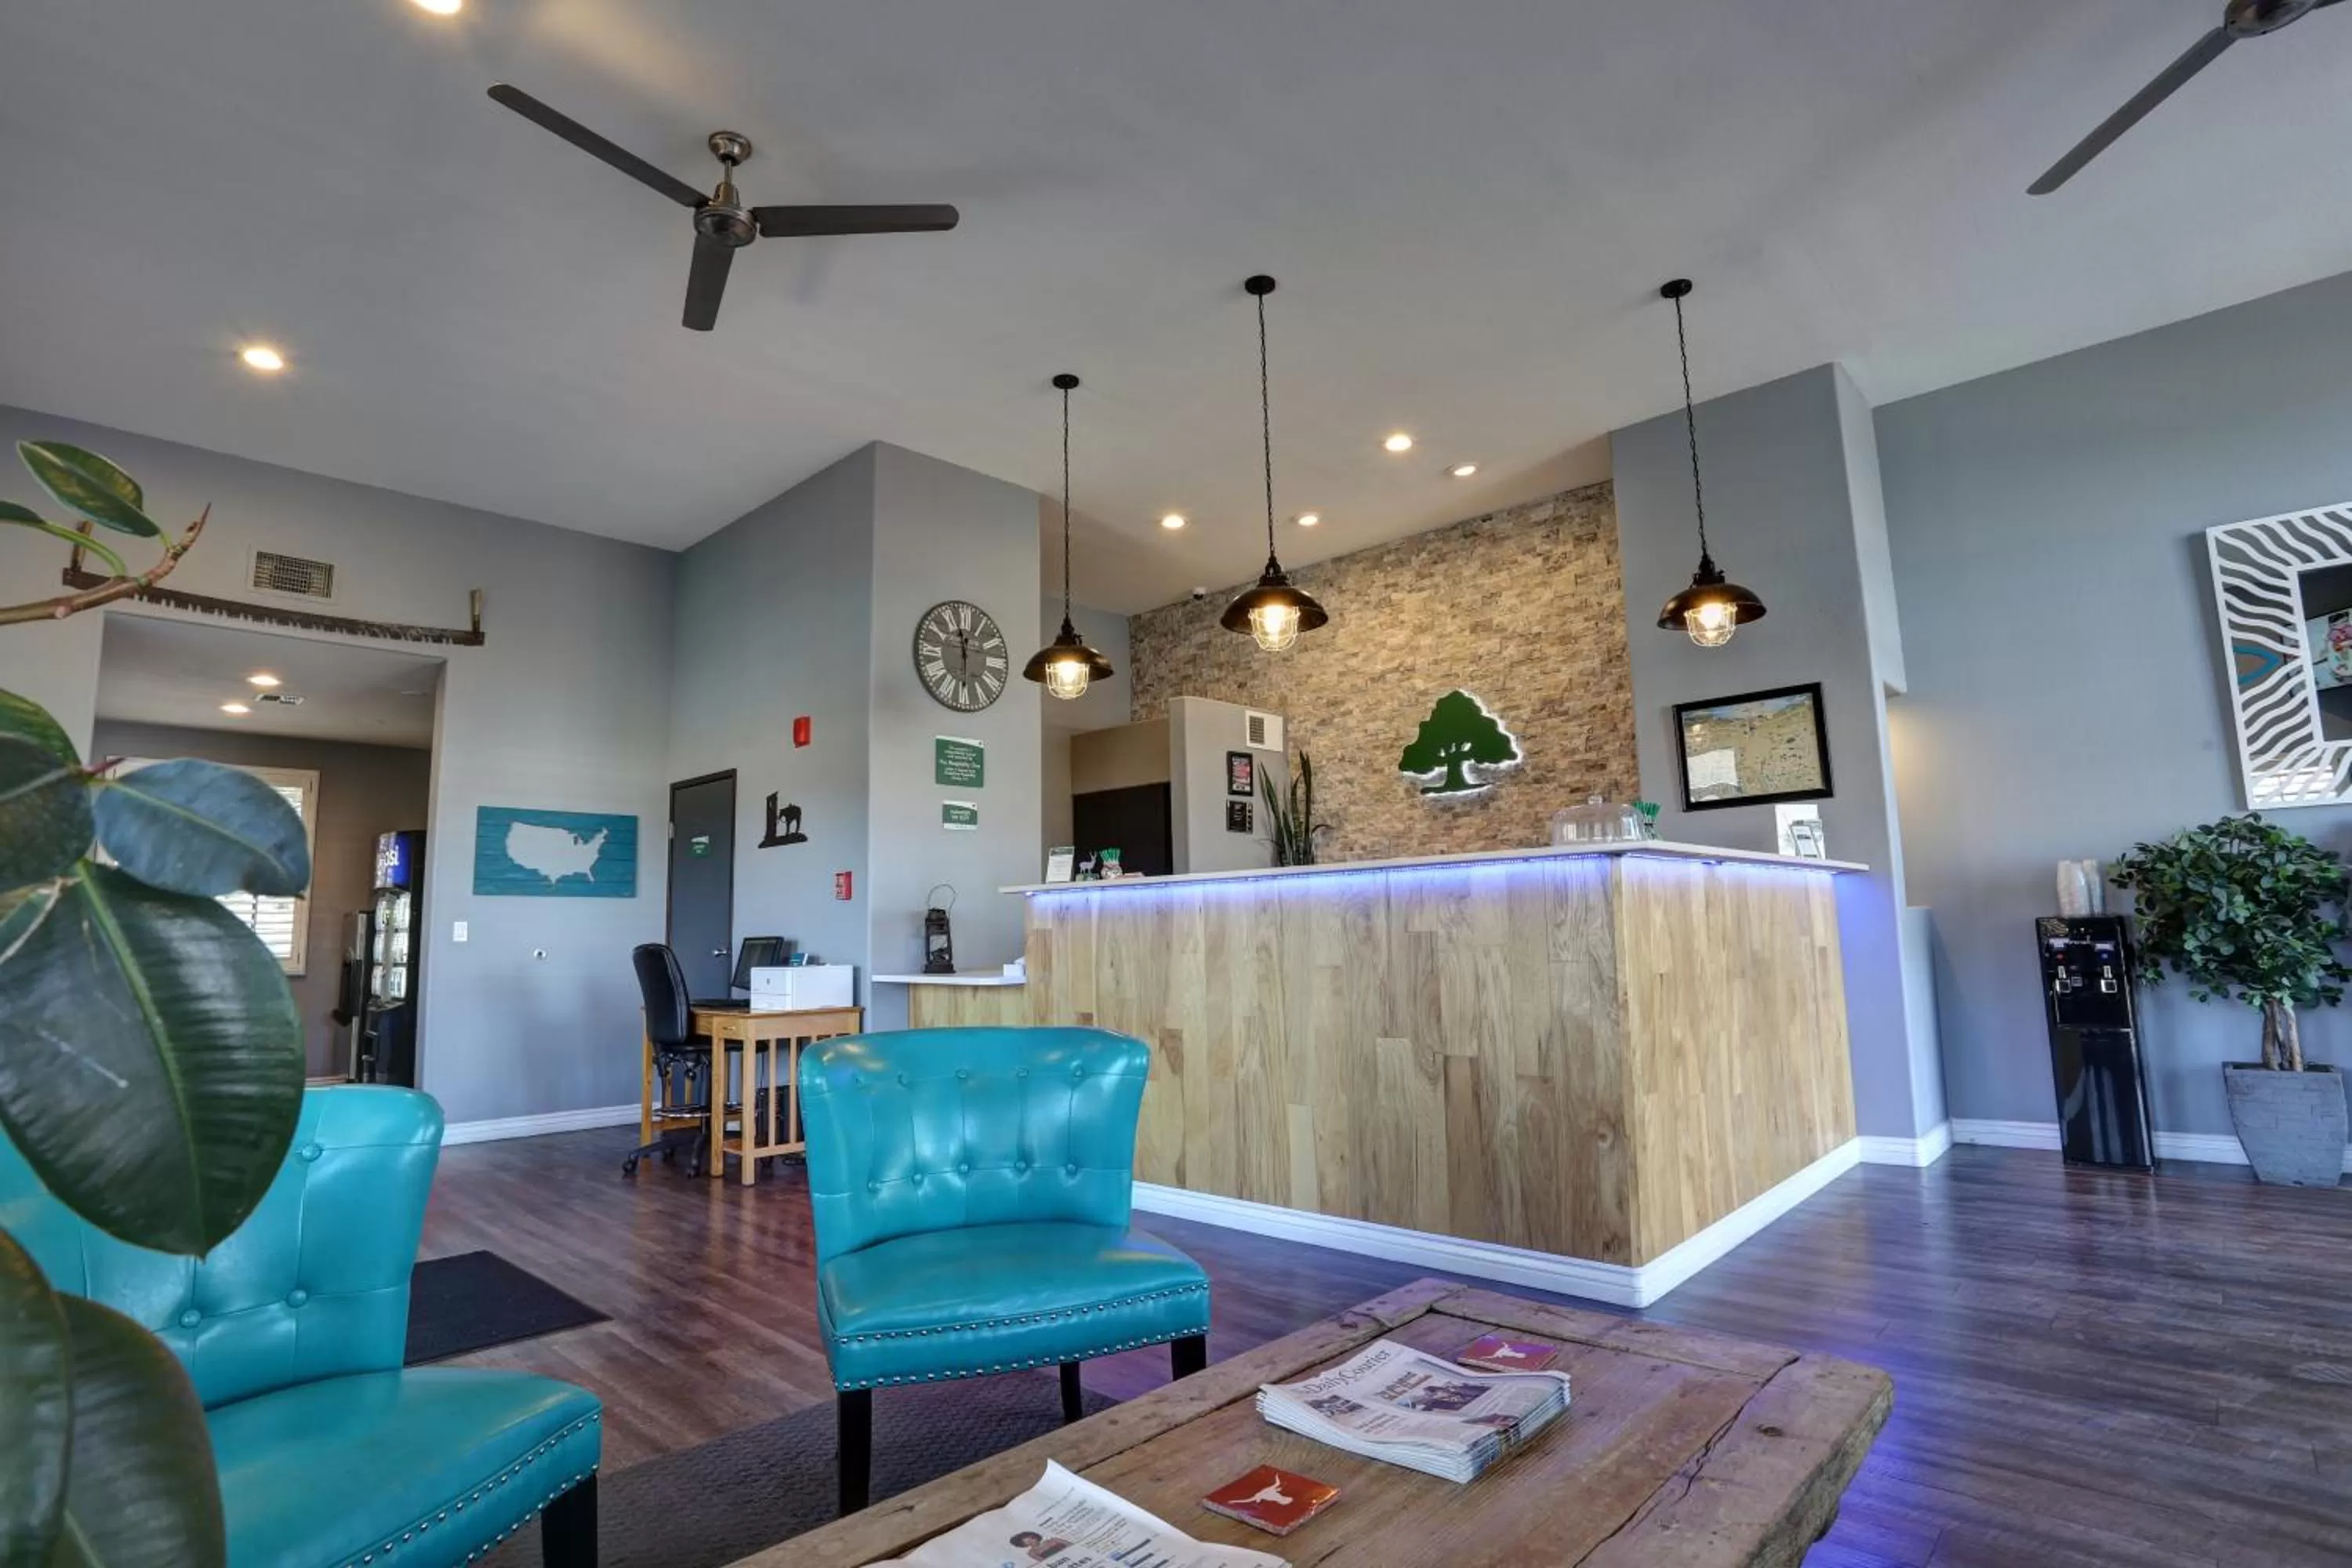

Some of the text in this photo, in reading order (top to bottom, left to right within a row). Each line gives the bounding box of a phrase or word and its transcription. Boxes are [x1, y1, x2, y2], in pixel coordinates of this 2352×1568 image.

[928, 621, 948, 641] X
[942, 609, 958, 632] XI
[958, 608, 971, 631] XII
[974, 616, 988, 637] I
[975, 681, 989, 705] V
[1302, 1376, 1349, 1394] Daily
[1338, 1349, 1390, 1382] Courier
